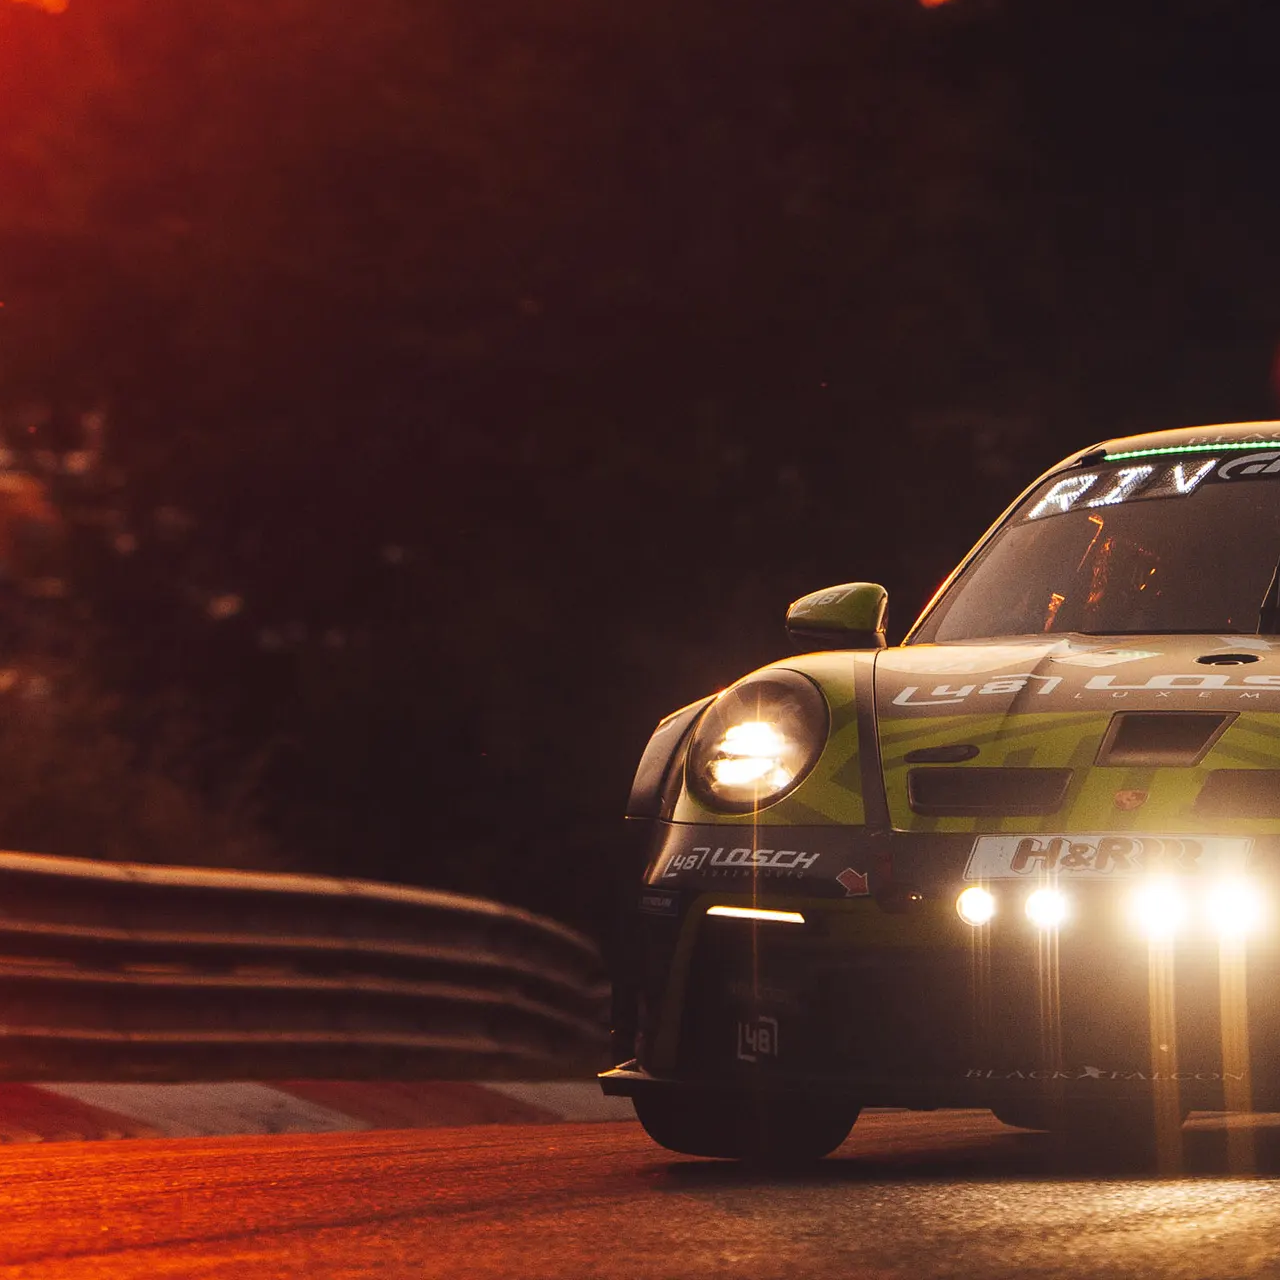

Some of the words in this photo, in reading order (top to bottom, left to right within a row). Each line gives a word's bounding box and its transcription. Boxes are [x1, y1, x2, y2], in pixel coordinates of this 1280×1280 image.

[709, 847, 821, 869] LOSCH
[1010, 837, 1136, 873] H&R
[965, 1068, 1073, 1080] BLACK
